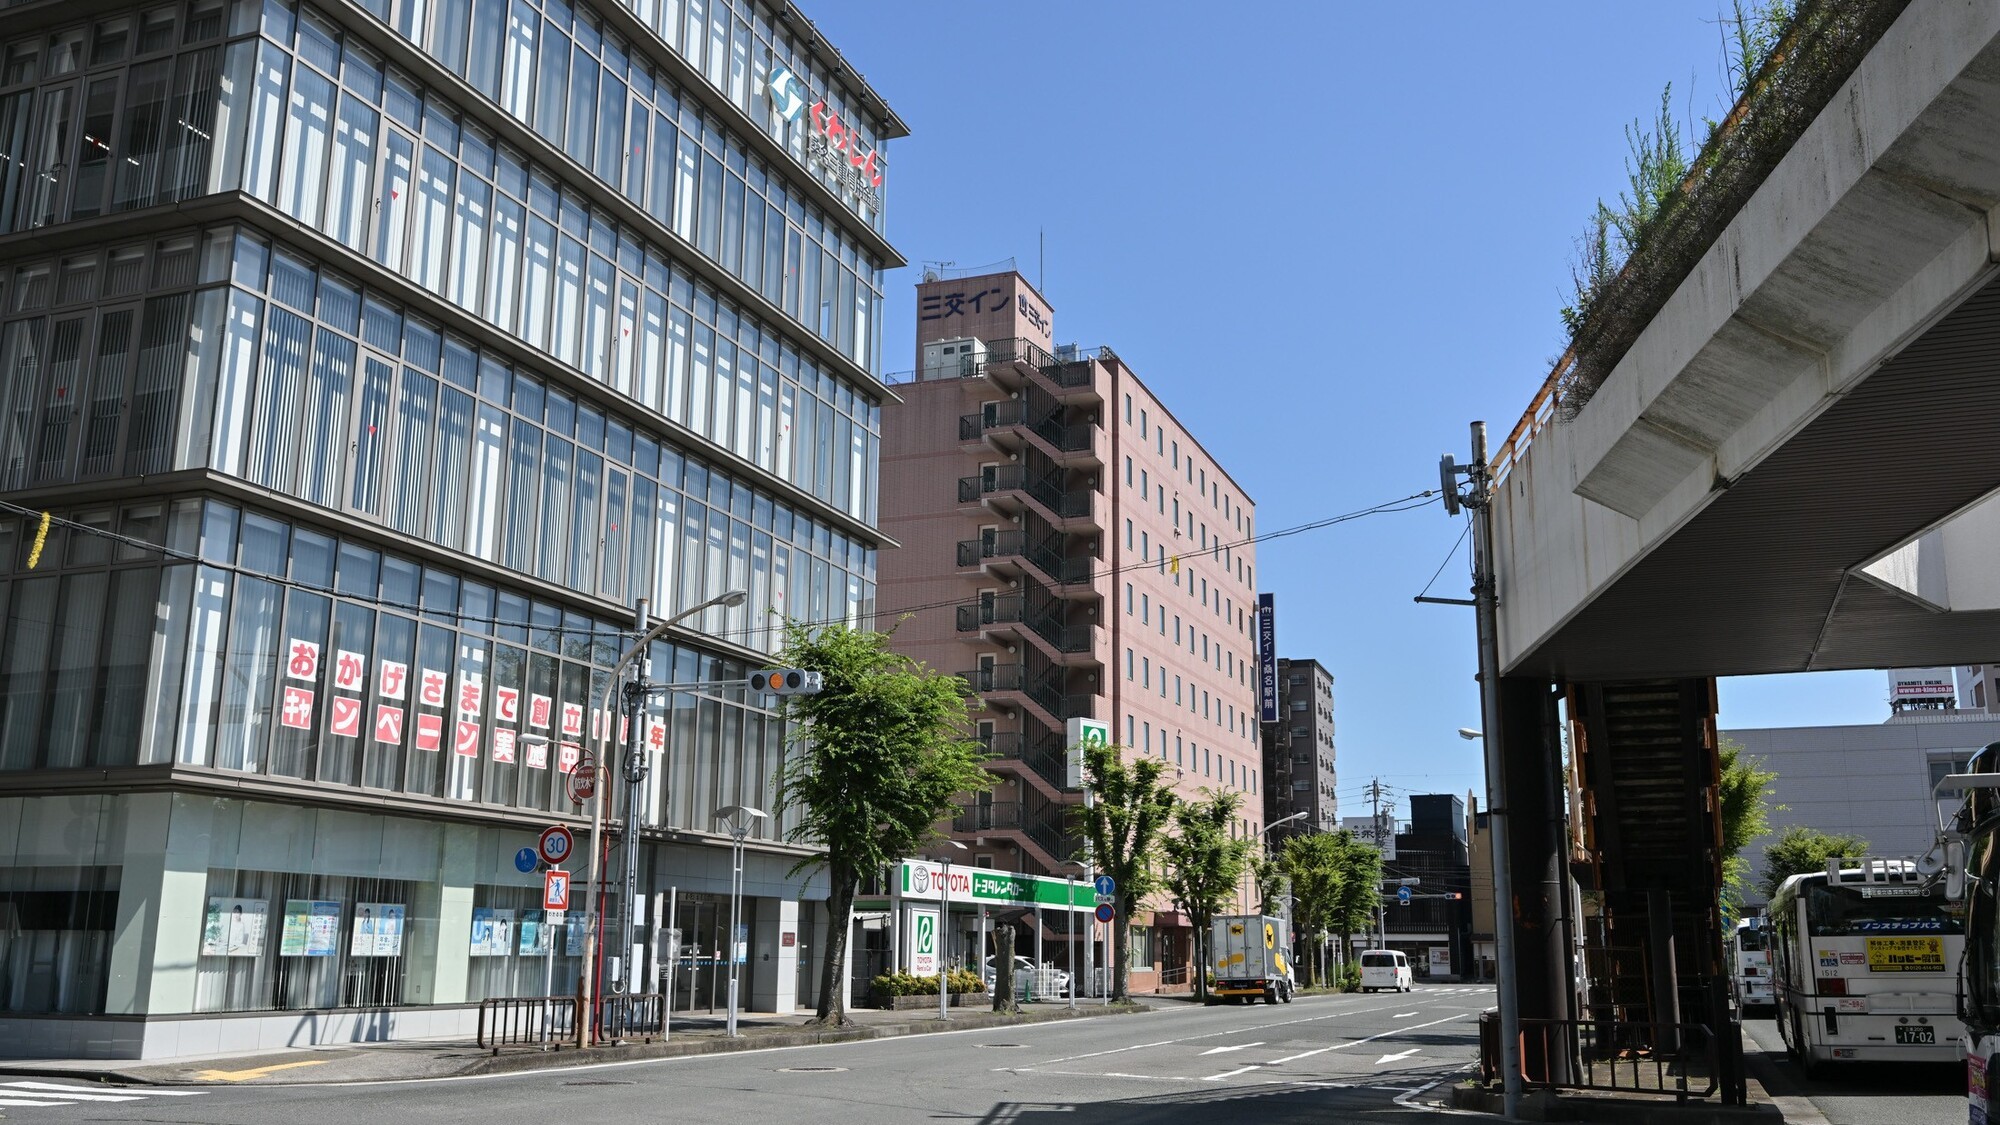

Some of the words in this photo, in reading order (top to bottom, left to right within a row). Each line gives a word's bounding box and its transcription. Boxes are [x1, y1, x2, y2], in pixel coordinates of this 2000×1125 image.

[922, 288, 1010, 320] 三交イン
[1028, 303, 1051, 339] 三交イン
[1262, 618, 1274, 709] 三交イン桑名駅前
[546, 837, 566, 854] 30
[931, 871, 970, 893] TOYOTA
[974, 878, 1024, 896] トヨタレンタカー
[1862, 922, 1941, 930] ノンステップバス
[1903, 1031, 1934, 1043] 17-02
